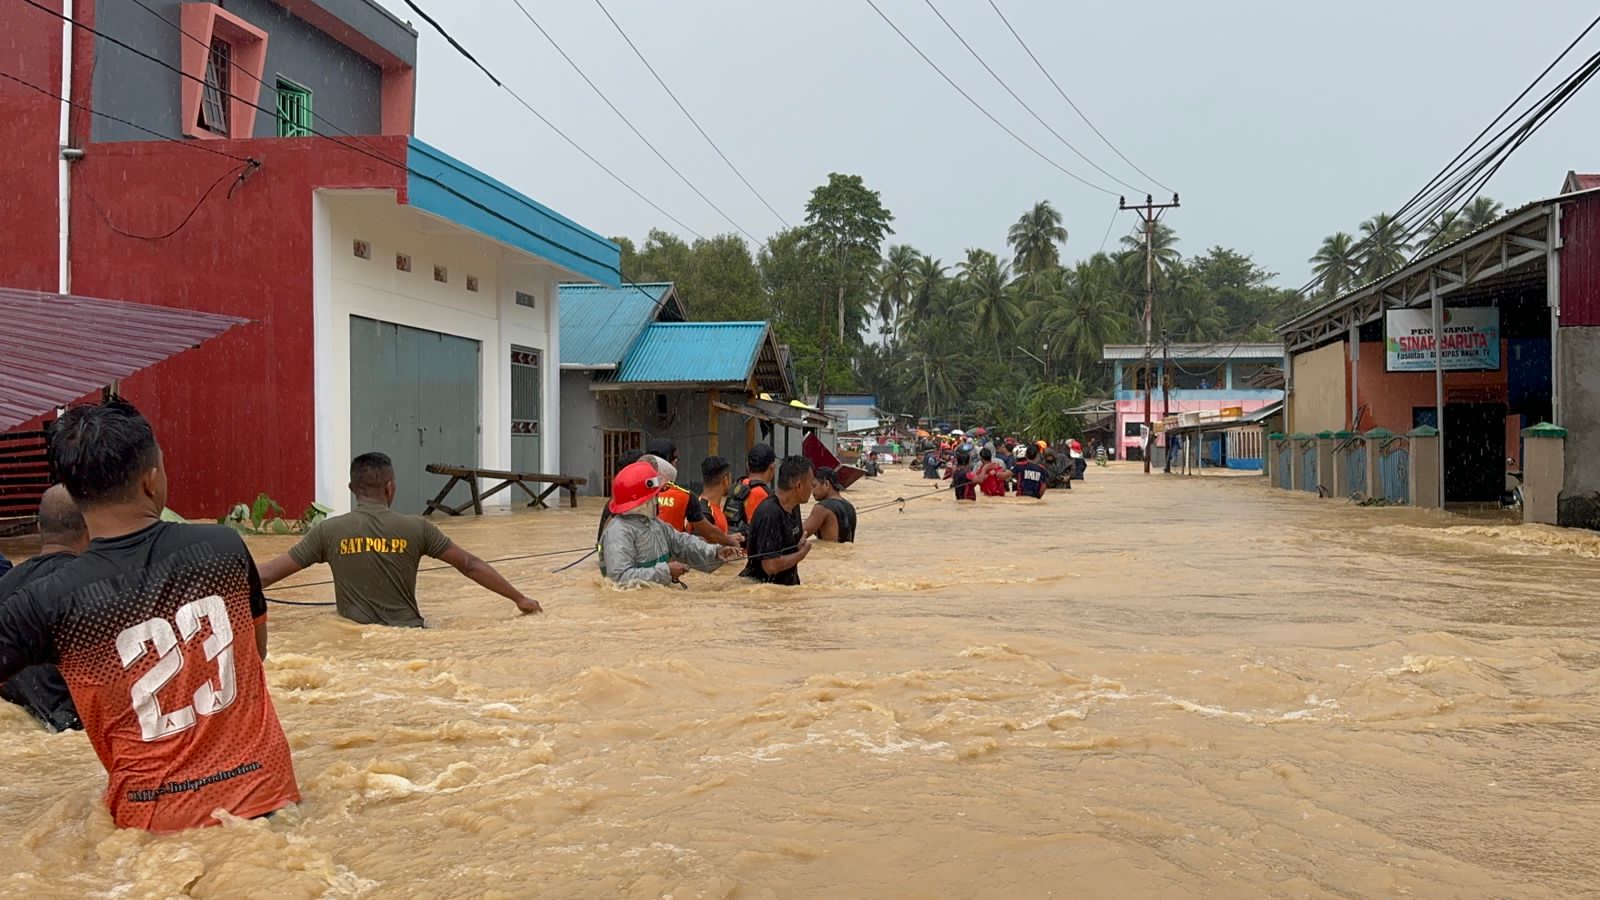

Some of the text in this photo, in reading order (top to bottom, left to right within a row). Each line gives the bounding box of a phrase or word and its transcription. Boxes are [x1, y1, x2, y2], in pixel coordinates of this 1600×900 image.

[1410, 326, 1474, 336] PENNAPAN
[340, 537, 408, 554] SAT POL PP
[115, 594, 238, 742] 23
